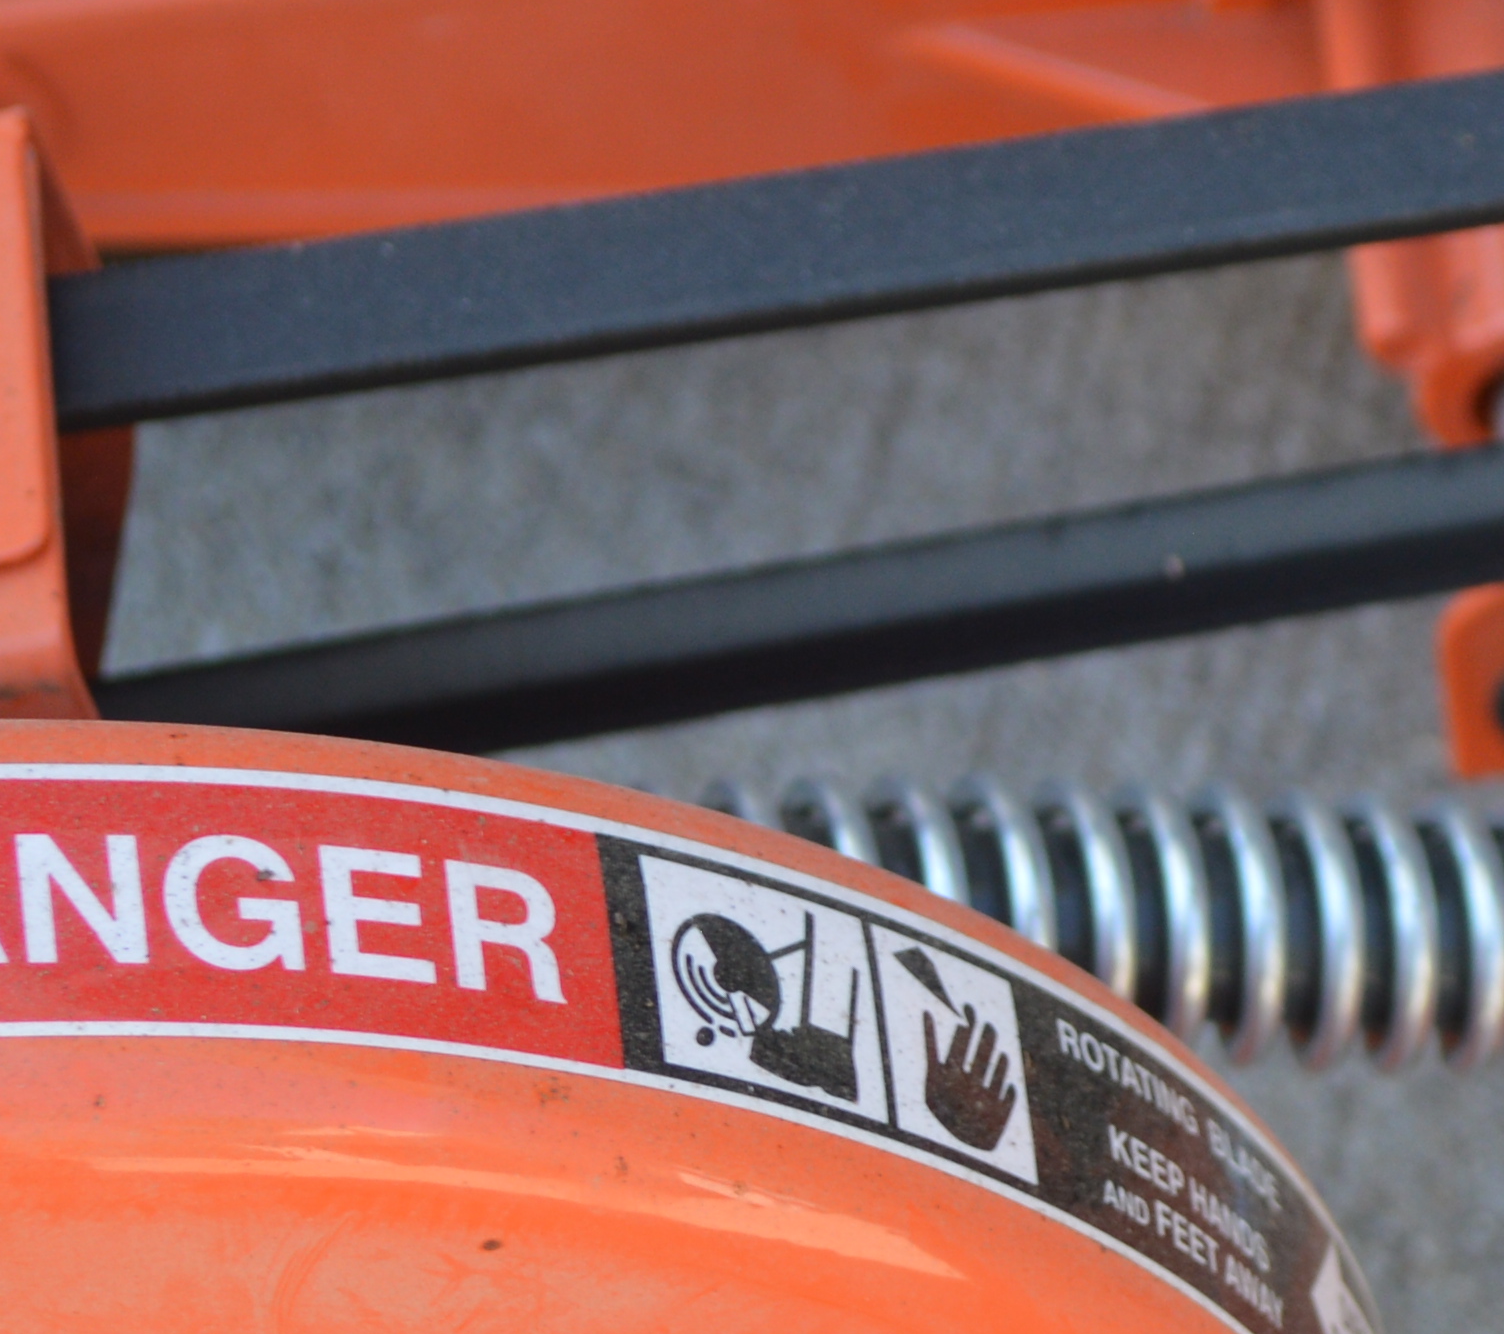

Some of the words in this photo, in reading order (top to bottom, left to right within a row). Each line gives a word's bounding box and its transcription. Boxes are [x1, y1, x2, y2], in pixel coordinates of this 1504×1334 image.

[1055, 1017, 1200, 1136] ROTATING
[1206, 1118, 1283, 1213] BLADE
[1102, 1179, 1151, 1227] AND
[1154, 1198, 1220, 1273] FEET
[1224, 1255, 1285, 1330] AWAY
[1107, 1124, 1185, 1199] KEEP
[1188, 1176, 1271, 1273] HANDS
